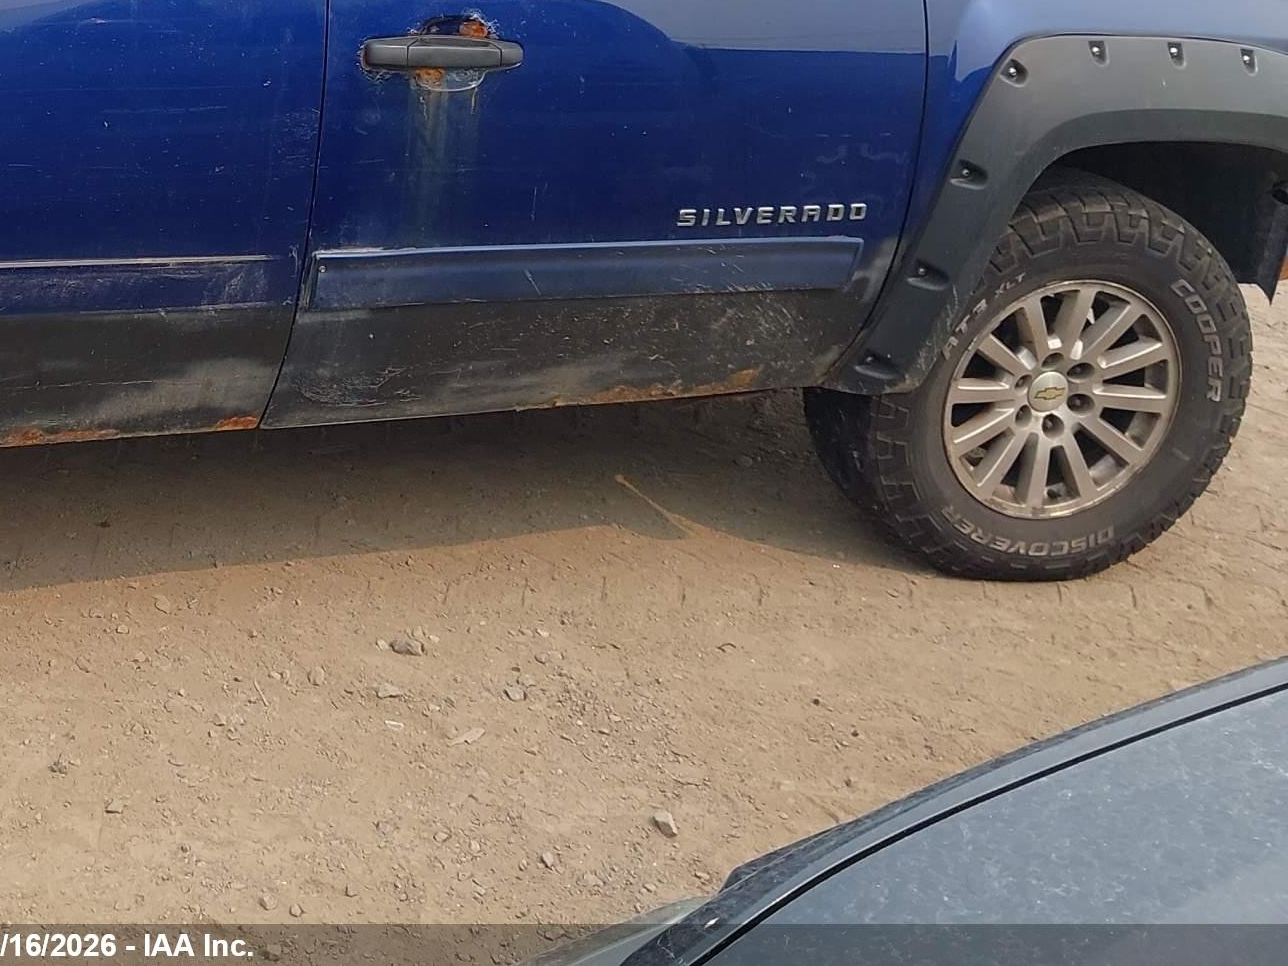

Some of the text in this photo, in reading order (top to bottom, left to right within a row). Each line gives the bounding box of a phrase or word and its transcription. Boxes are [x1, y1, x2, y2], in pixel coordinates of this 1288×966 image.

[676, 202, 869, 227] SILVERADO
[1172, 278, 1223, 402] COOPER
[941, 505, 1114, 557] DISCOVERER
